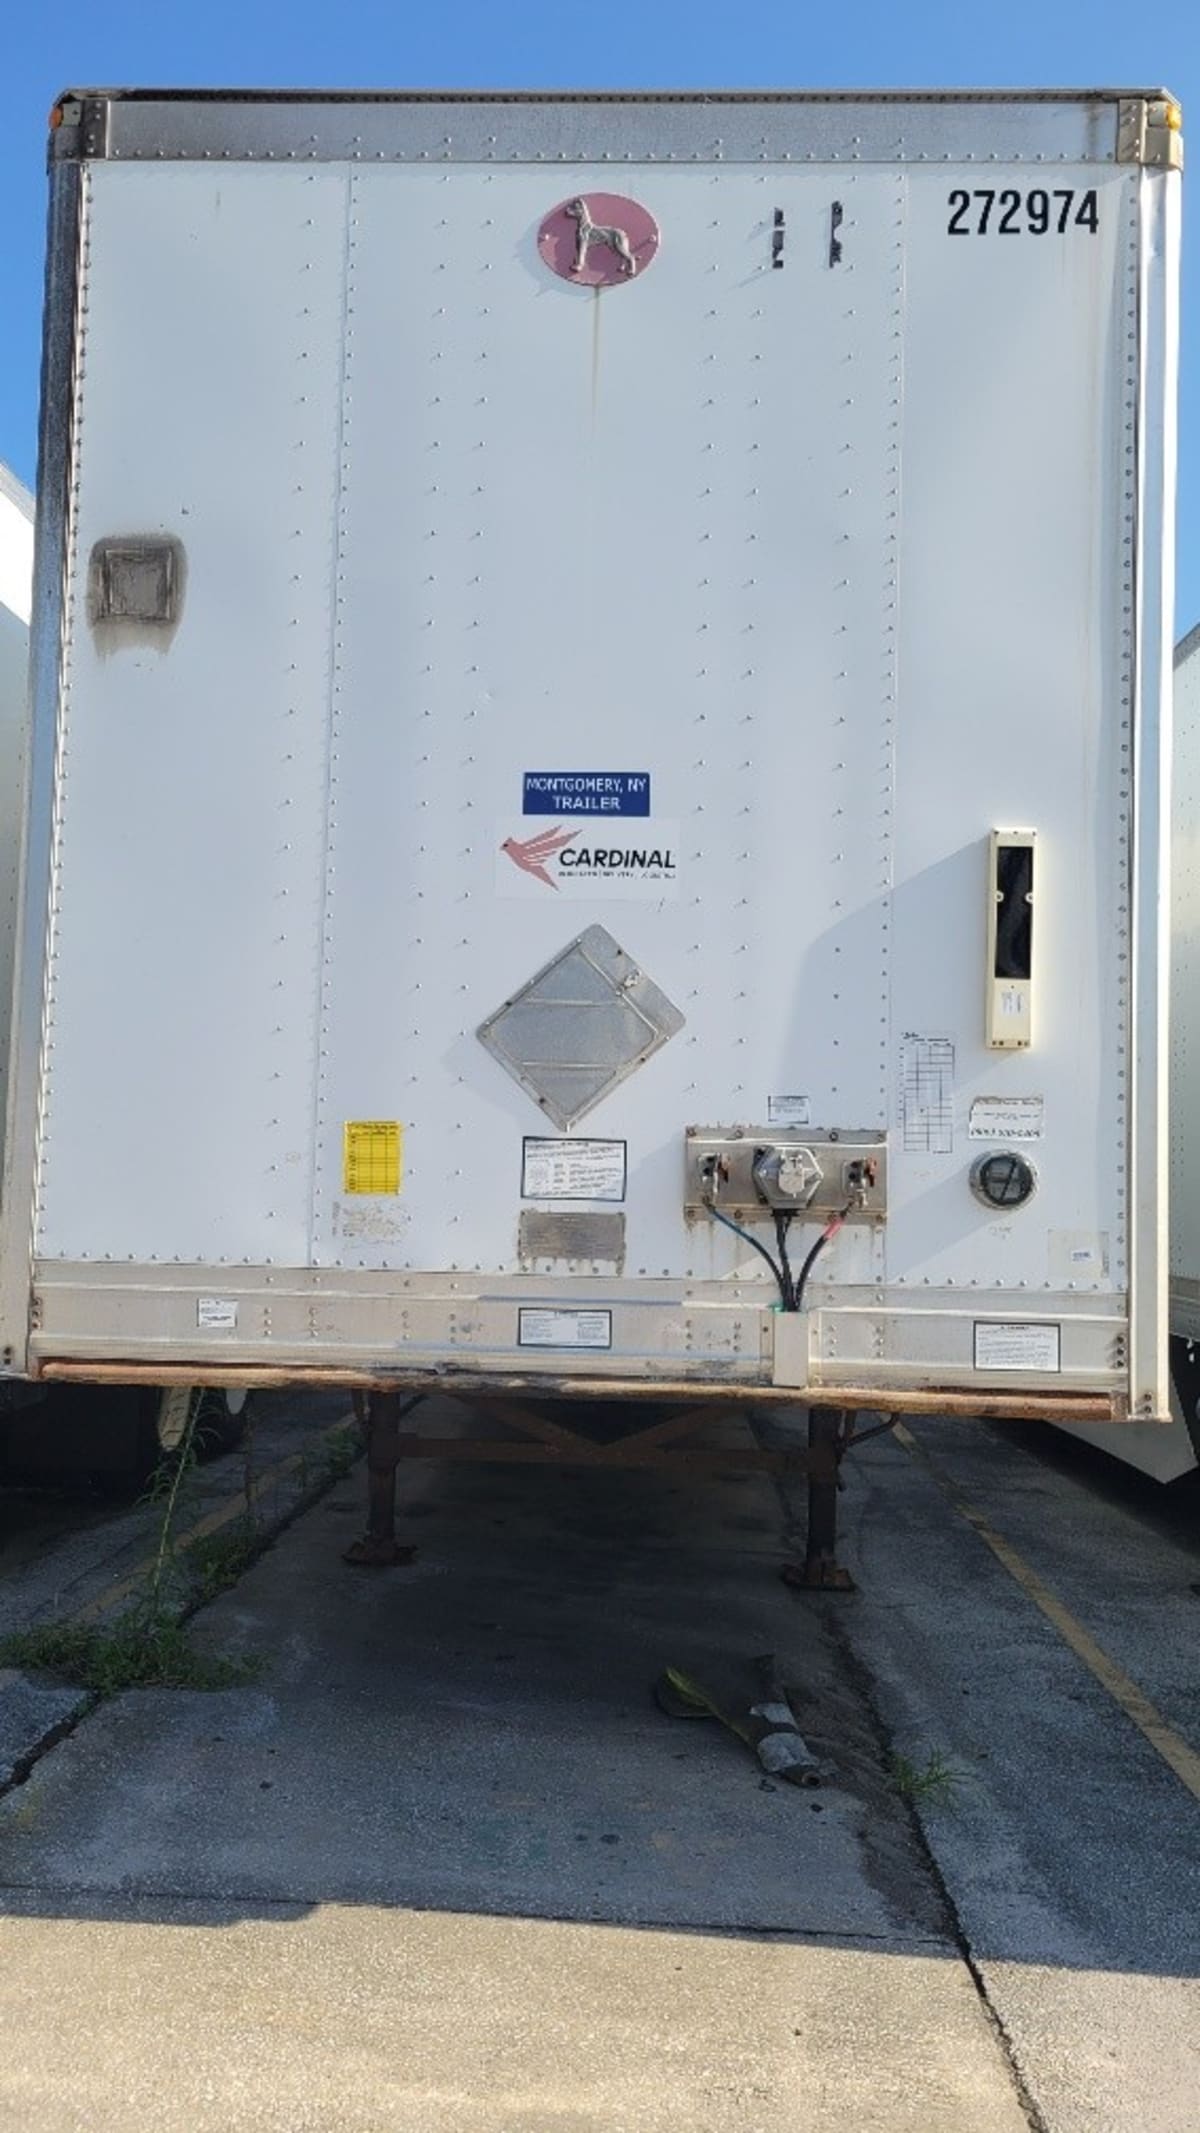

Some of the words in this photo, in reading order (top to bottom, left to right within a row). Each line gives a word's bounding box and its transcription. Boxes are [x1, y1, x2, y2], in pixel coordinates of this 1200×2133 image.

[947, 189, 1099, 235] 272974
[526, 777, 623, 793] MONTGOMERY,
[627, 778, 647, 792] NY
[552, 795, 621, 810] TRAILER
[559, 848, 676, 869] CARDINAL
